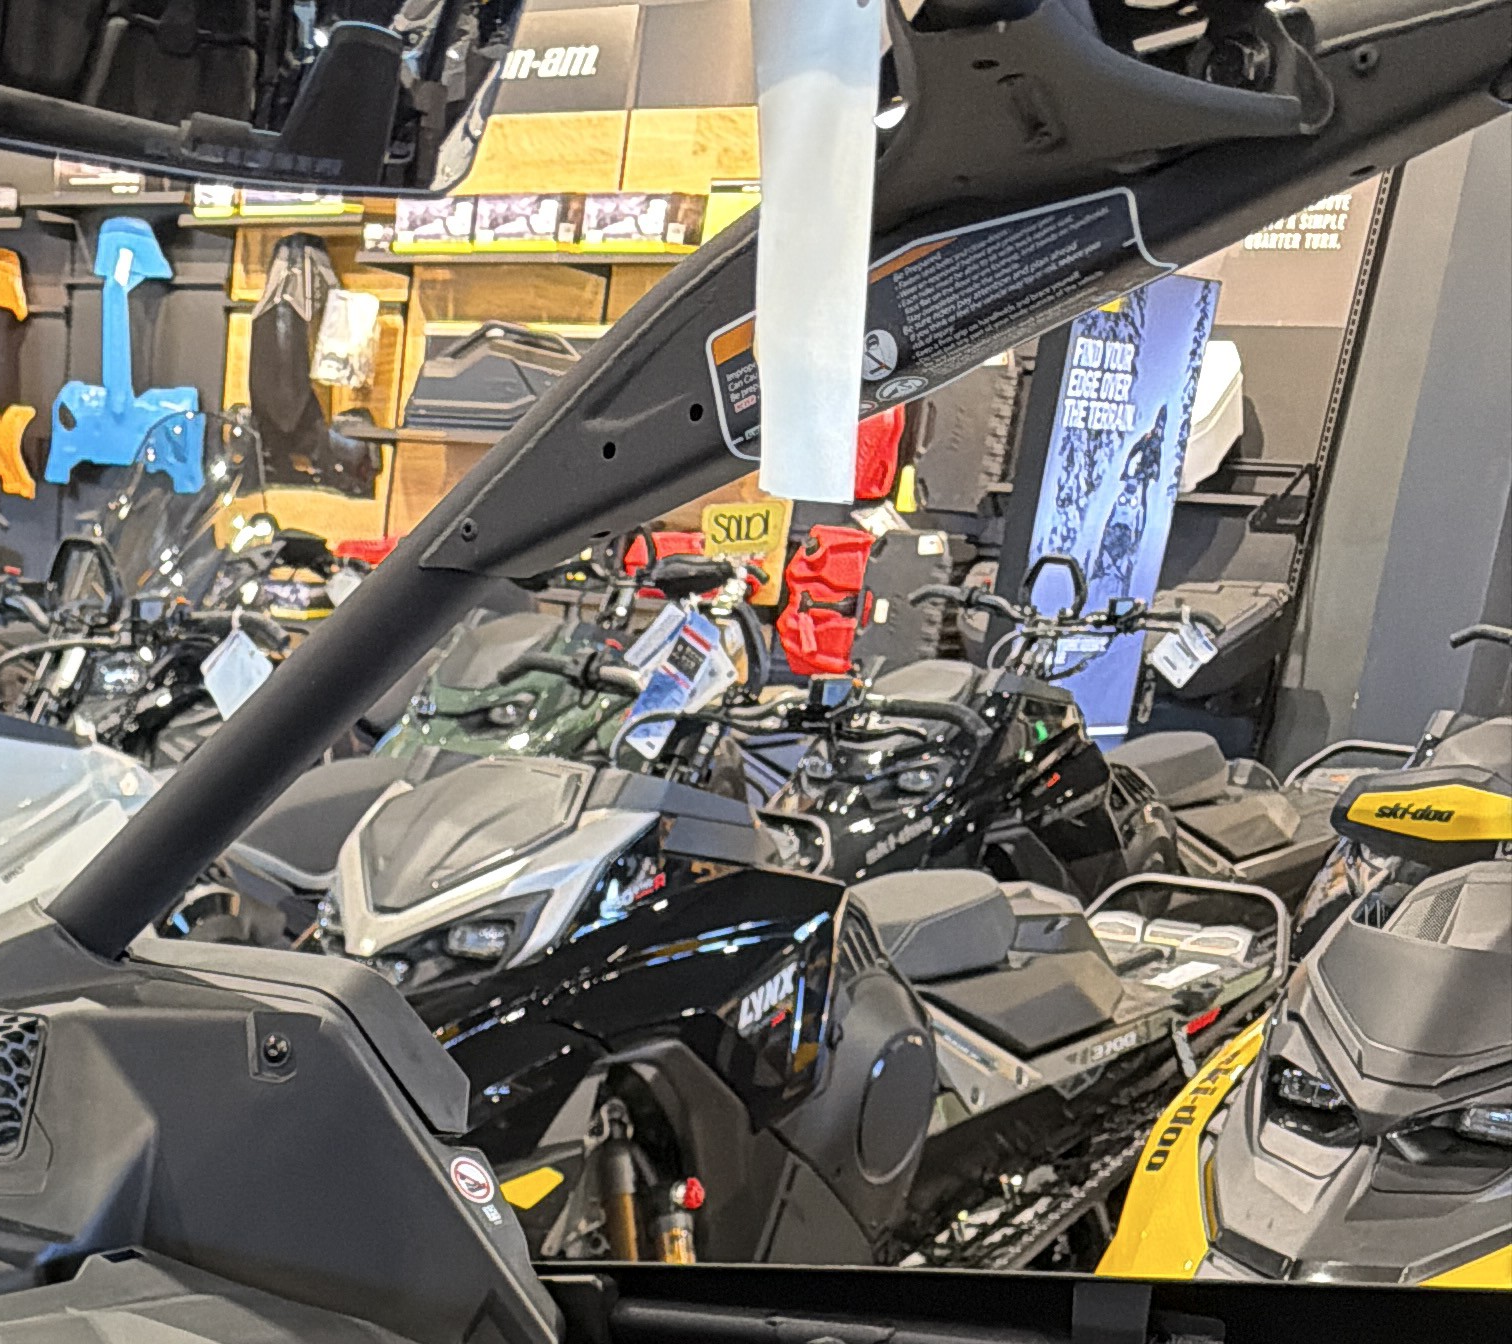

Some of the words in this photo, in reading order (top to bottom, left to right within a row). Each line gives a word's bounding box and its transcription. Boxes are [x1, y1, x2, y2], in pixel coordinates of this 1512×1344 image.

[500, 44, 599, 80] n-am
[1299, 213, 1348, 231] SIMPLE
[1244, 233, 1301, 250] QUARTER
[892, 270, 903, 282] Be
[904, 250, 941, 276] Prepared
[1073, 337, 1104, 368] FIND
[1104, 341, 1135, 372] YOUR
[1067, 368, 1102, 399] EDGE
[1100, 372, 1133, 402] OVER
[1062, 398, 1089, 429] THE
[1375, 802, 1456, 822] ski-doo
[865, 815, 933, 866] ski-doo
[737, 961, 799, 1031] LYNX
[1145, 1048, 1241, 1172] ski-doo
